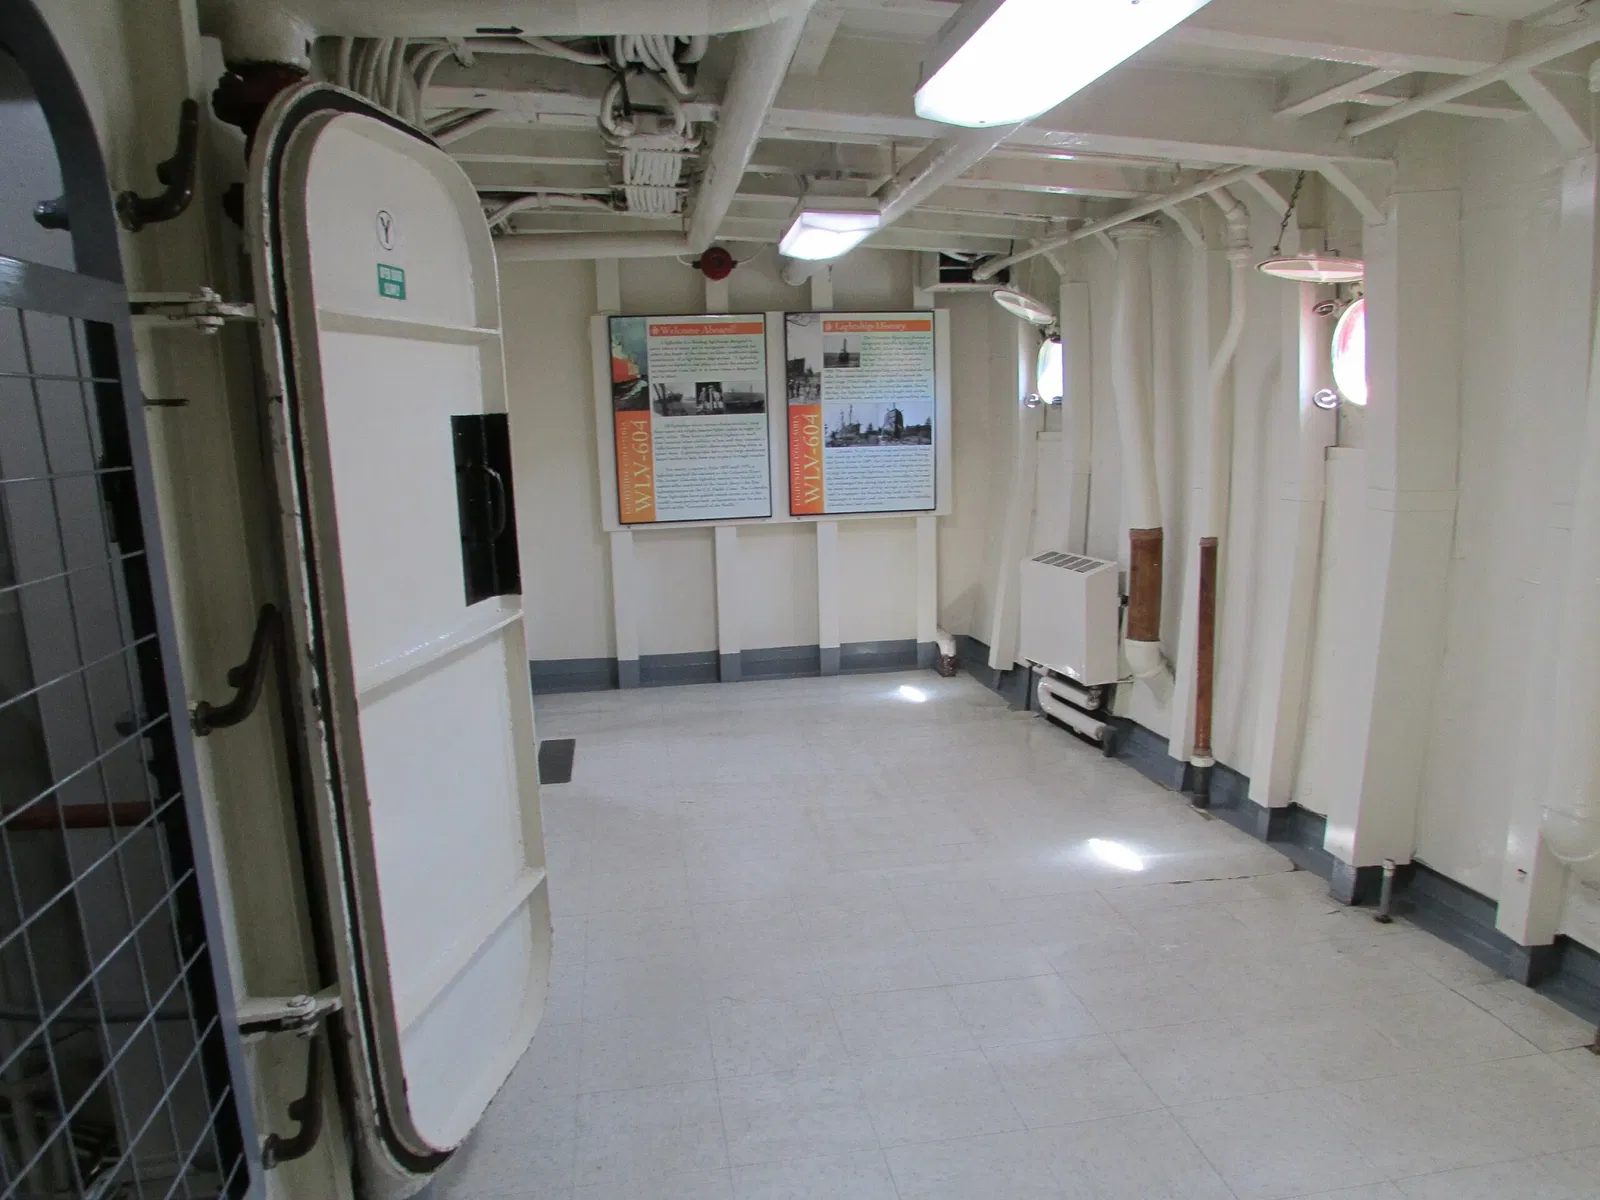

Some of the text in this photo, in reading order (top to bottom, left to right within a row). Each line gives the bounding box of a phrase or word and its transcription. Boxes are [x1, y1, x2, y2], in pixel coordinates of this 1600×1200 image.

[380, 216, 390, 244] Y
[660, 326, 701, 335] Welcome
[834, 321, 907, 332] Lightship History
[630, 420, 652, 512] WLV-604
[792, 415, 801, 506] LIGHTSHIP COLUMBIA
[802, 413, 821, 504] WLV-604
